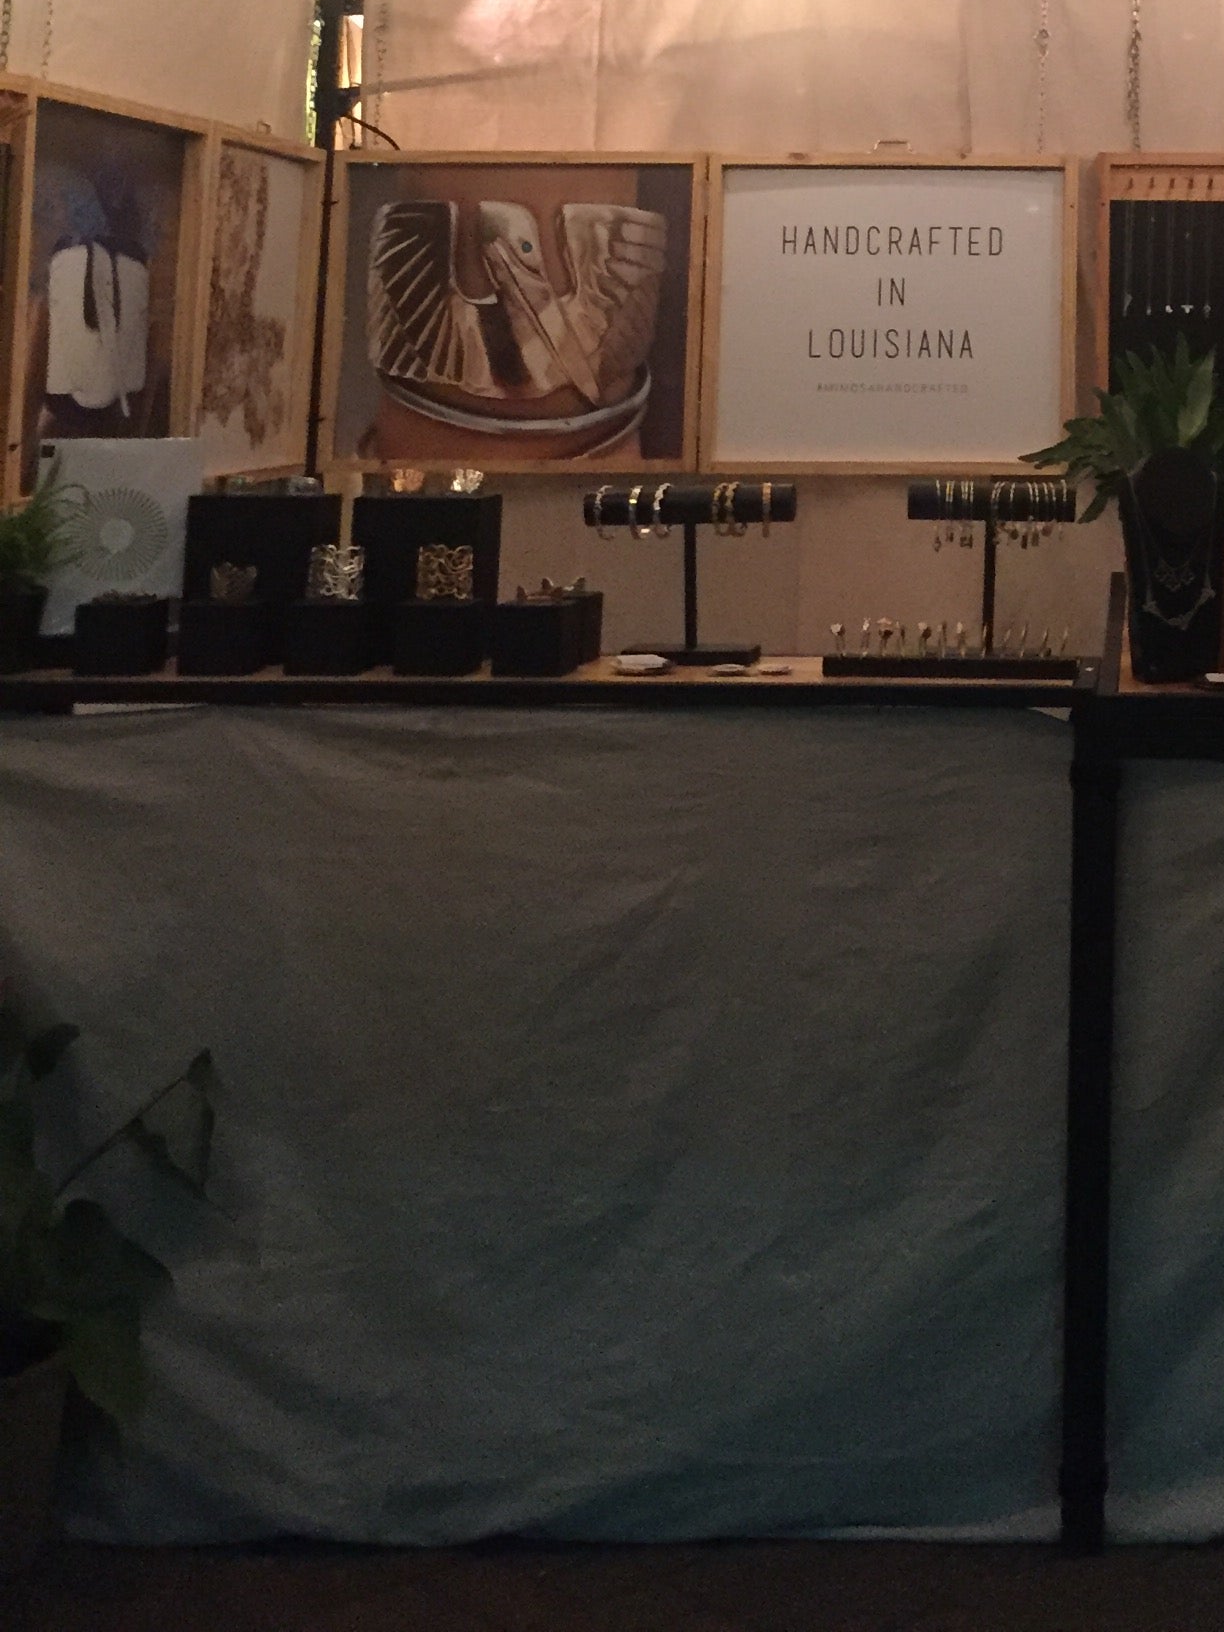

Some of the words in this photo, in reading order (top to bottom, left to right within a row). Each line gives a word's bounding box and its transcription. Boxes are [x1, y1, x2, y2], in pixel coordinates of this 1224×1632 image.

[782, 225, 1004, 256] HANDCRAFTED
[877, 277, 906, 306] IN
[808, 328, 974, 359] LOUISIANA
